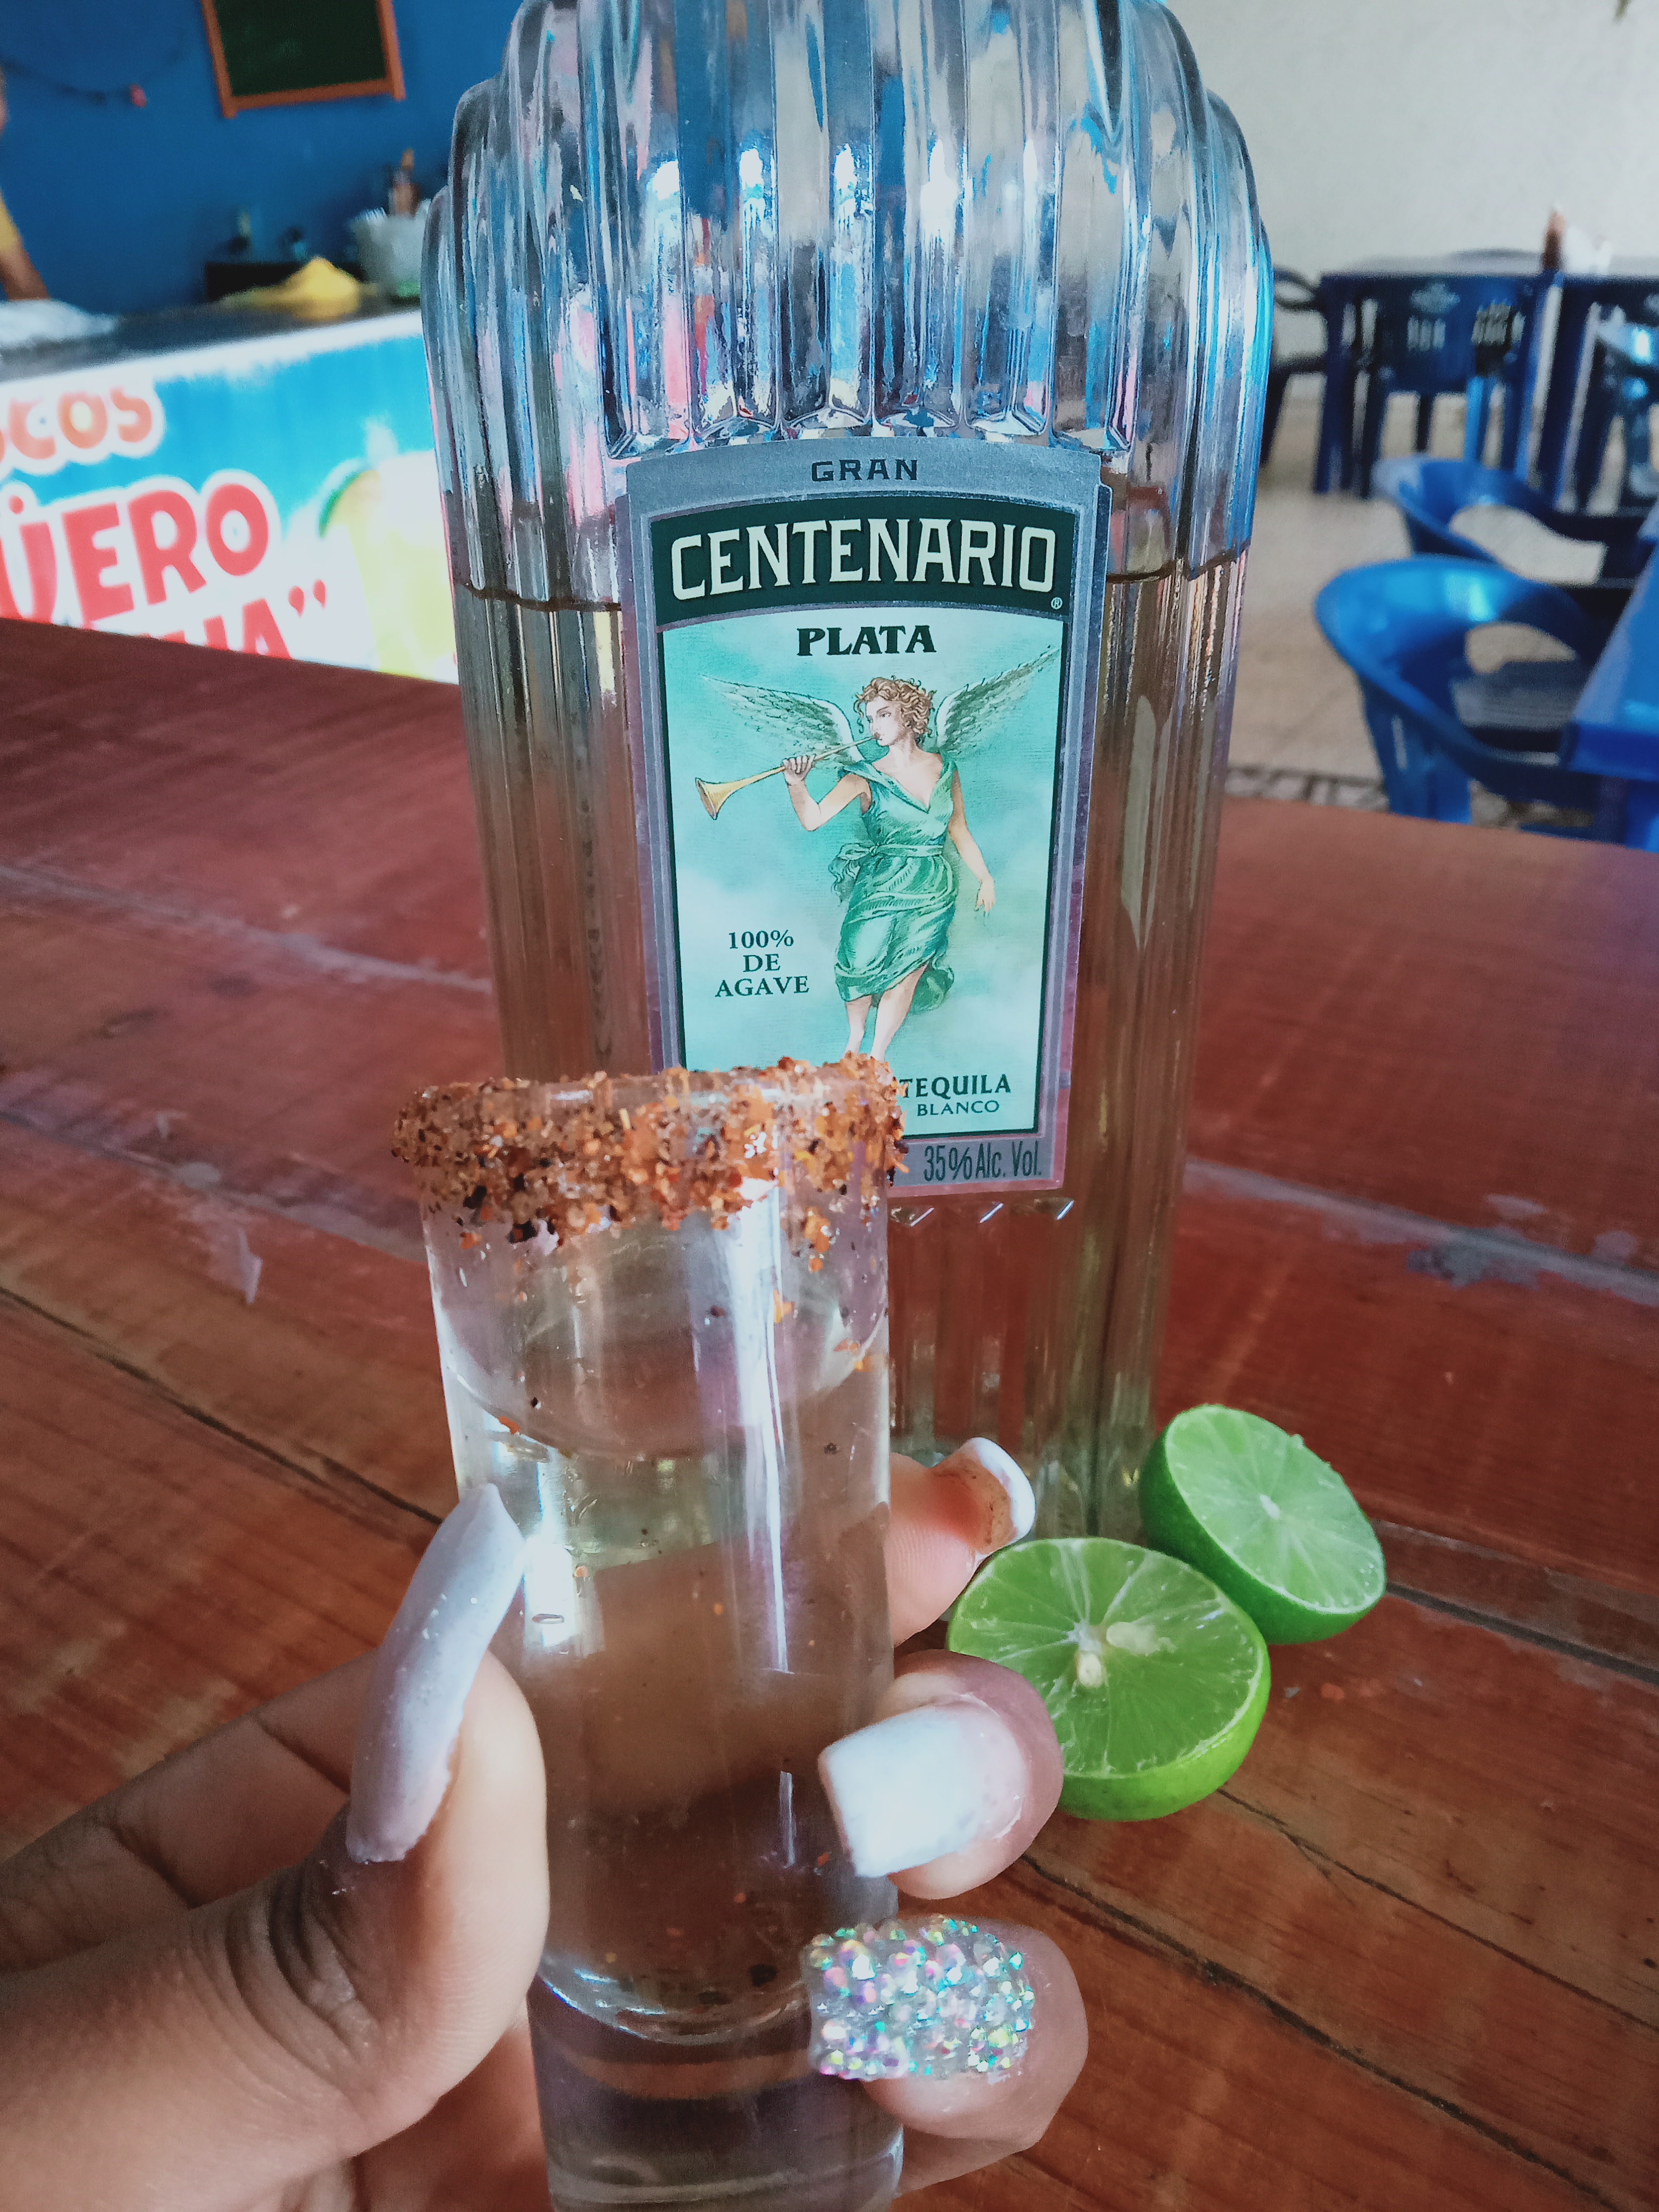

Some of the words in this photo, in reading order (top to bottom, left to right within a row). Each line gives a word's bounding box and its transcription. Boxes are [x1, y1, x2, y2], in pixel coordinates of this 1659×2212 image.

[0, 386, 153, 464] COS
[811, 458, 918, 482] GRAN
[671, 518, 1056, 600] CENTENARIO
[797, 625, 936, 656] PLATA
[728, 929, 794, 949] 100%
[743, 953, 781, 972] DE
[715, 975, 809, 998] AGAVE
[899, 1074, 1011, 1100] TEQUILA
[917, 1100, 1000, 1117] BLANCO
[1012, 1139, 1042, 1177] Vol.
